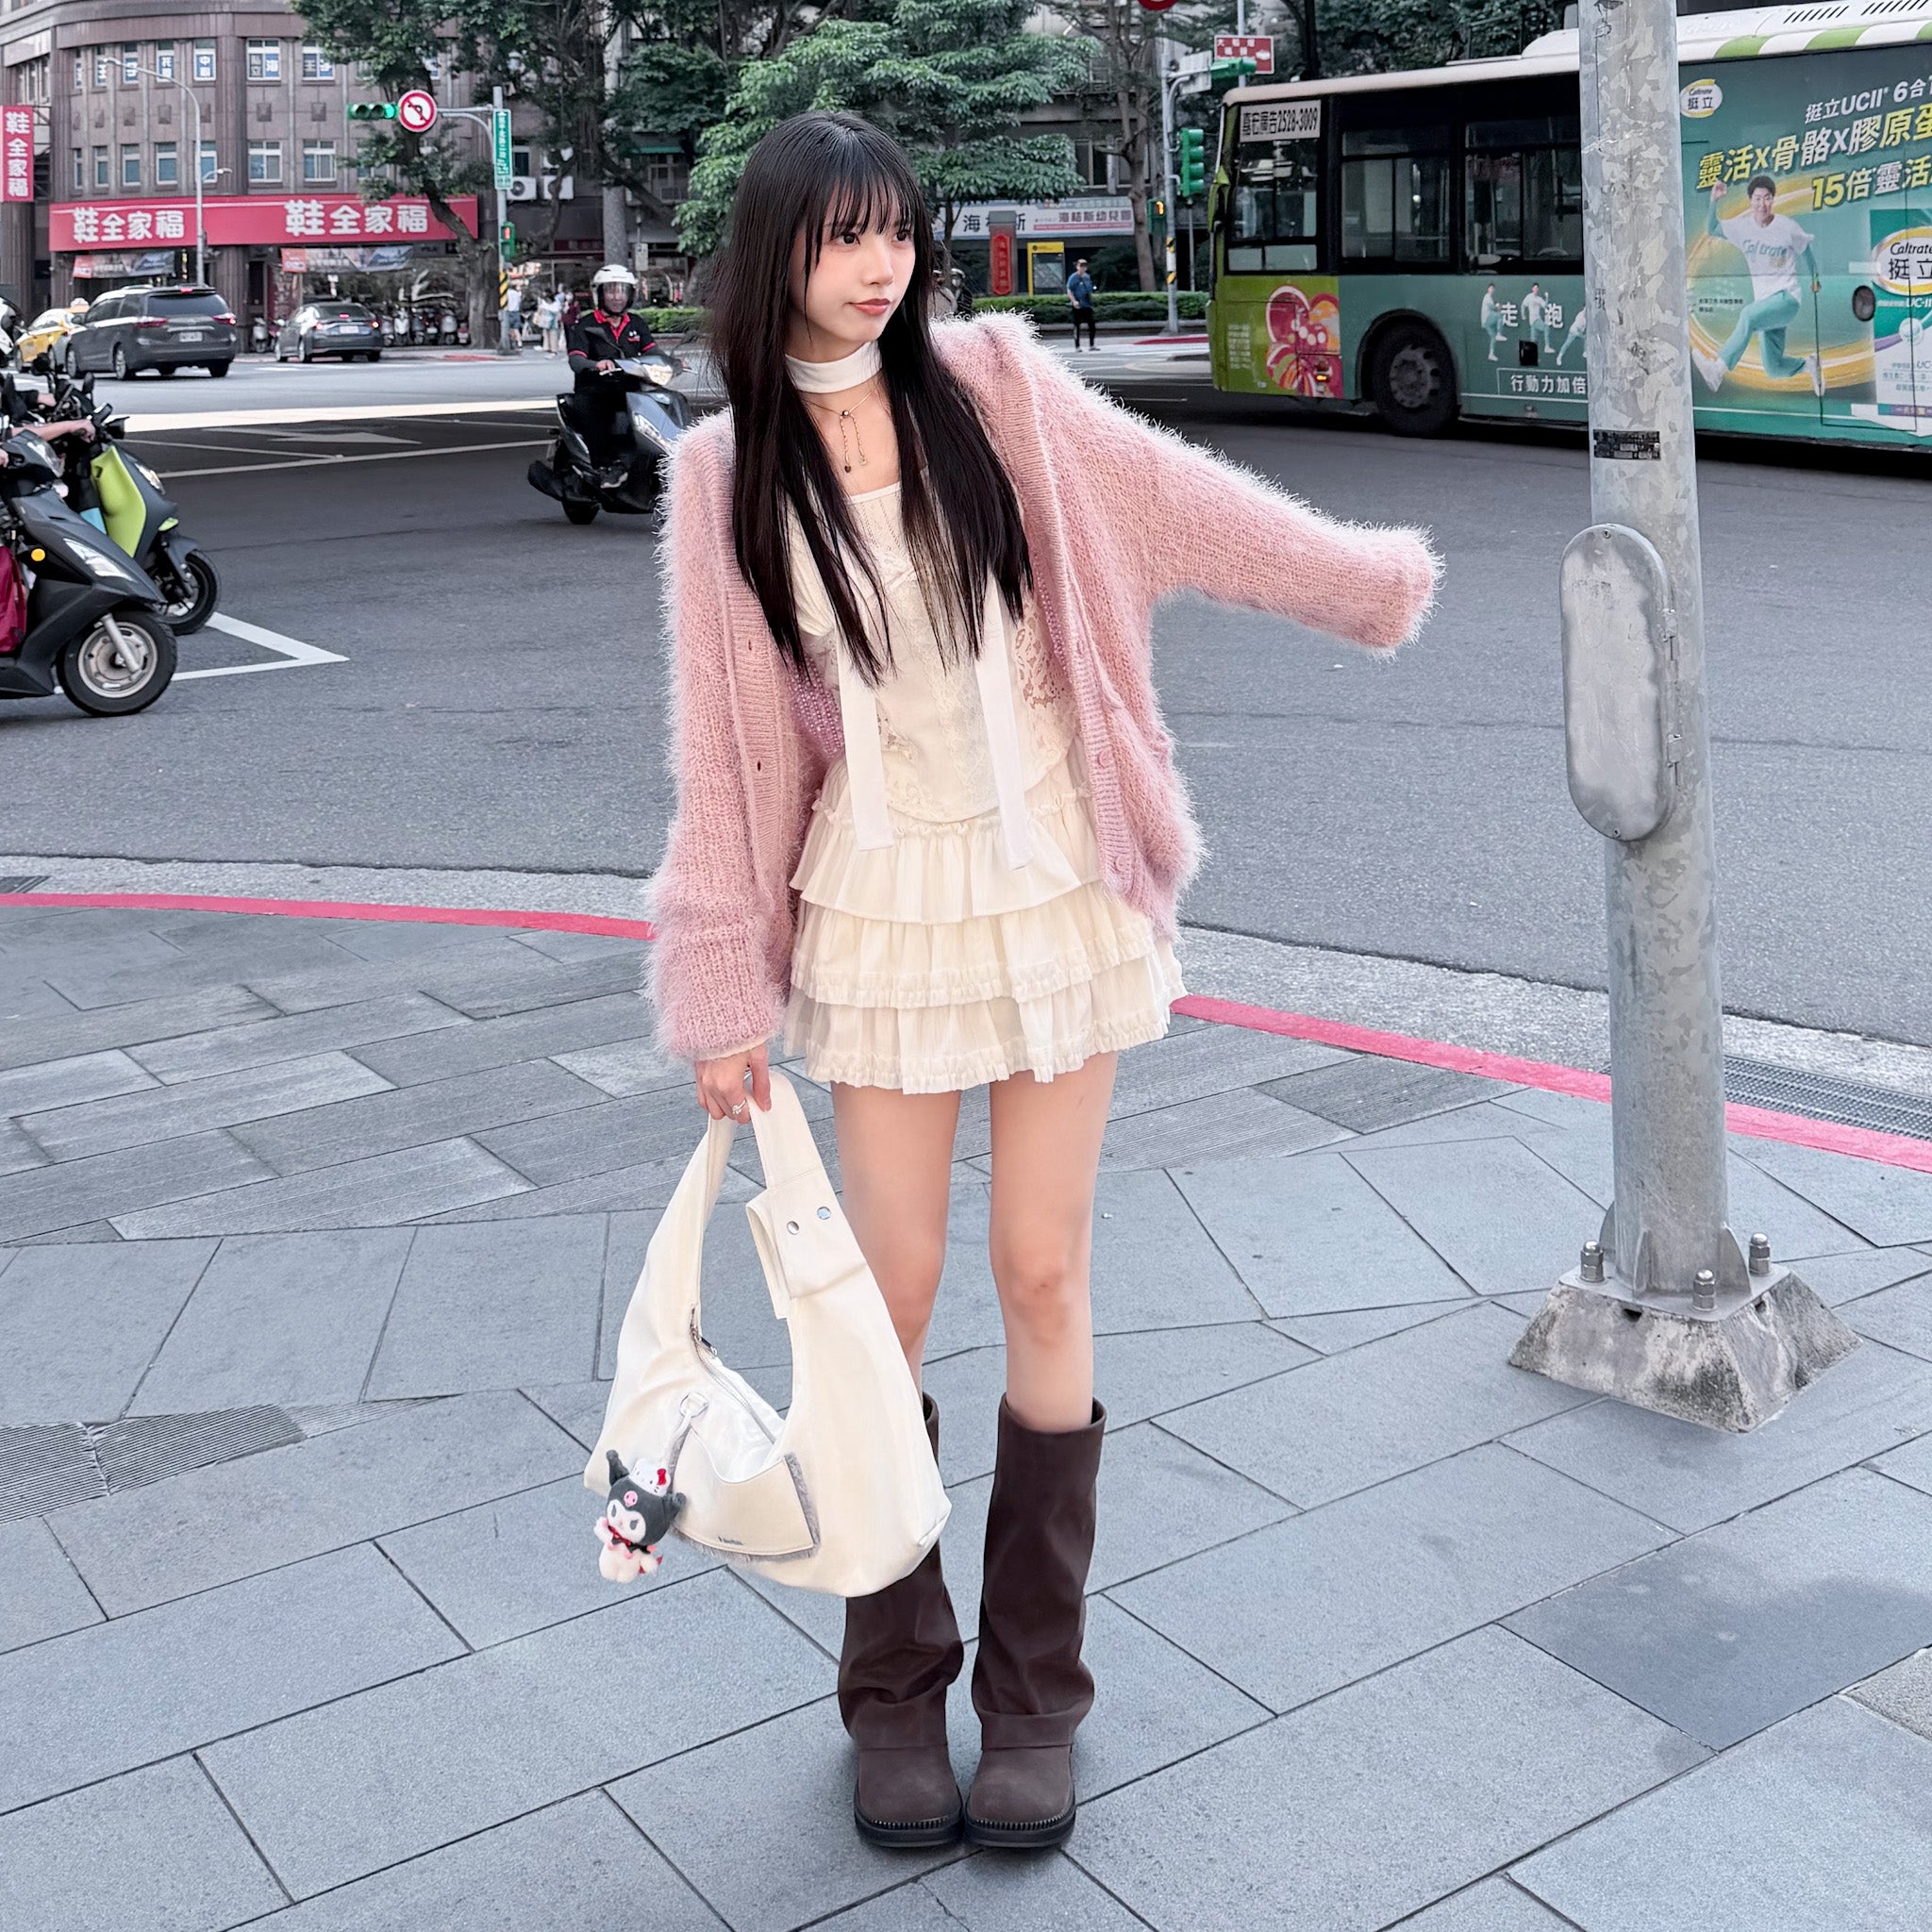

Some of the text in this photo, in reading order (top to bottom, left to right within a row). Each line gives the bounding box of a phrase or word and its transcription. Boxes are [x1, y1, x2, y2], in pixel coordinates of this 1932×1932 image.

[1892, 75, 1932, 104] 6合
[5, 110, 30, 197] 鞋全家福
[72, 207, 185, 243] 鞋全家福
[284, 199, 428, 237] 鞋全家福
[1501, 301, 1563, 329] 走 跑
[1510, 375, 1587, 394] 行動力加倍
